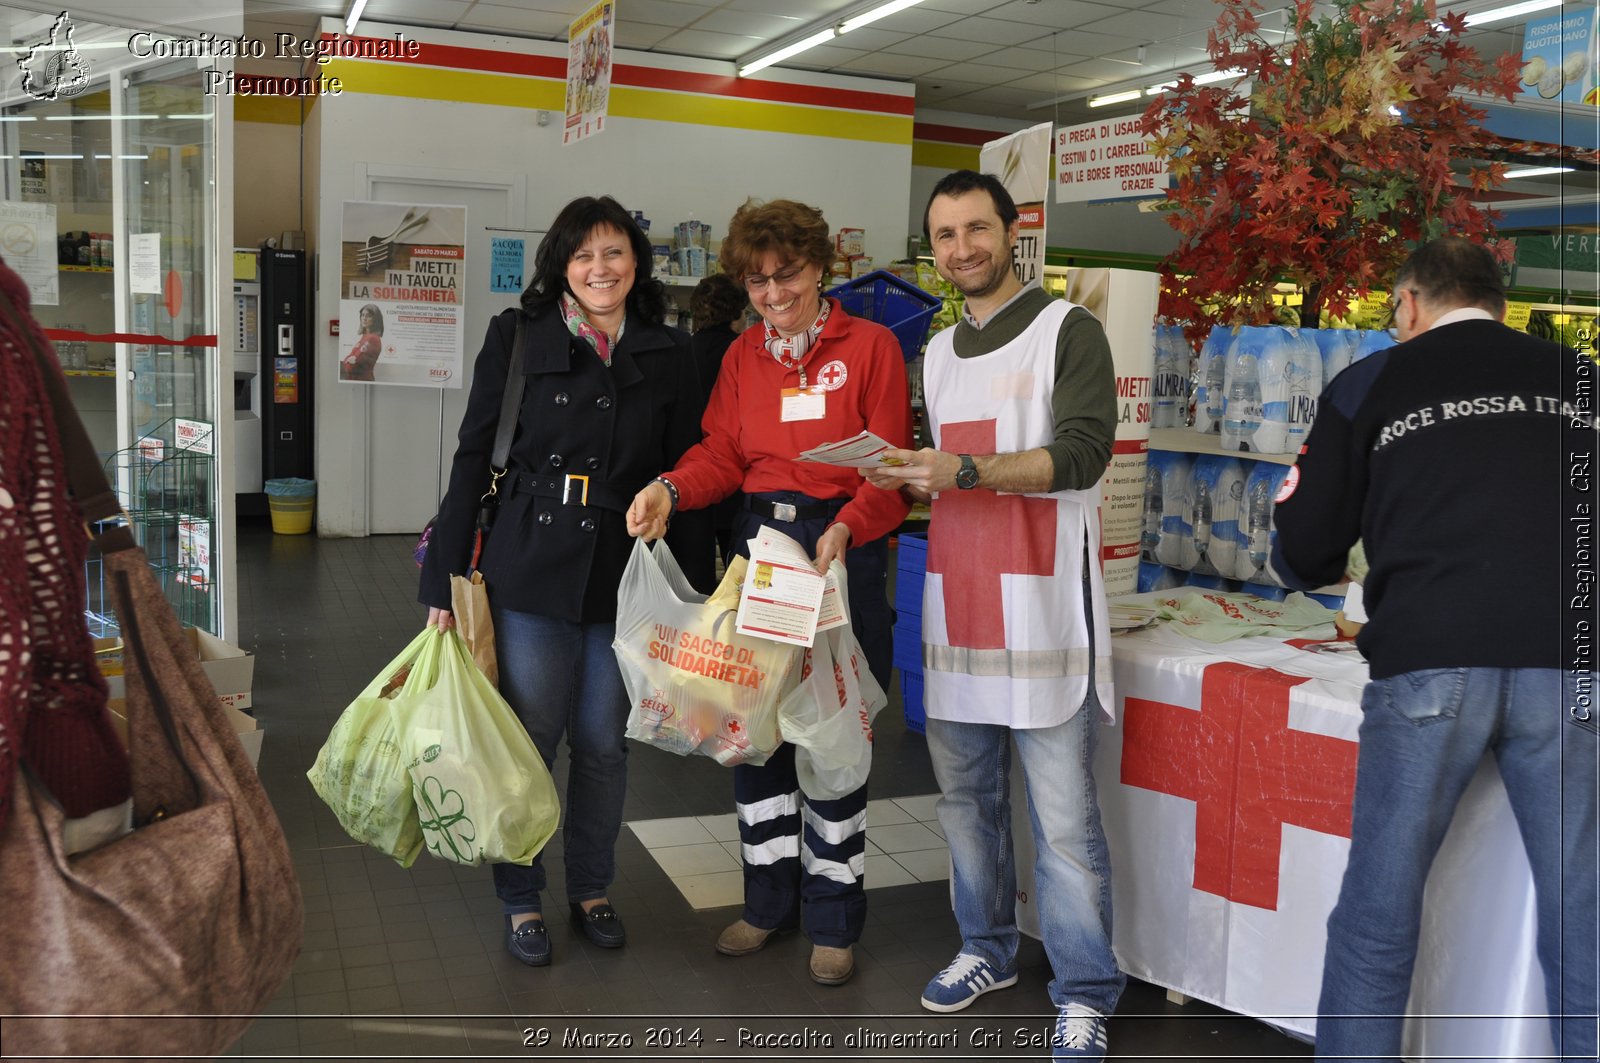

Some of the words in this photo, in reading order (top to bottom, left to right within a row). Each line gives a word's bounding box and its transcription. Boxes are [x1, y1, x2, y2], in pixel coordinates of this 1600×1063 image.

[1059, 133, 1066, 146] SI
[1069, 128, 1096, 143] PREGA
[1100, 125, 1110, 139] DI
[1114, 119, 1141, 136] USAR
[1061, 151, 1087, 166] CESTINI
[1090, 148, 1095, 161] O
[1099, 147, 1103, 160] I
[1059, 169, 1073, 185] NON
[1076, 168, 1084, 182] LE
[1087, 167, 1111, 181] BORSE
[1114, 161, 1163, 180] PERSONALI
[1121, 178, 1154, 191] GRAZIE
[1024, 213, 1039, 222] MARZO
[414, 248, 433, 256] SABATO
[415, 261, 457, 275] METTI
[389, 273, 402, 286] IN
[406, 274, 456, 289] TAVOLA
[496, 274, 522, 290] 1,74
[353, 285, 370, 298] LA
[373, 286, 457, 303] SOLIDARIETÀ
[429, 368, 449, 377] SELEX
[1441, 395, 1527, 420] ROSSA
[679, 631, 734, 661] SACCO
[640, 698, 669, 714] SELEX
